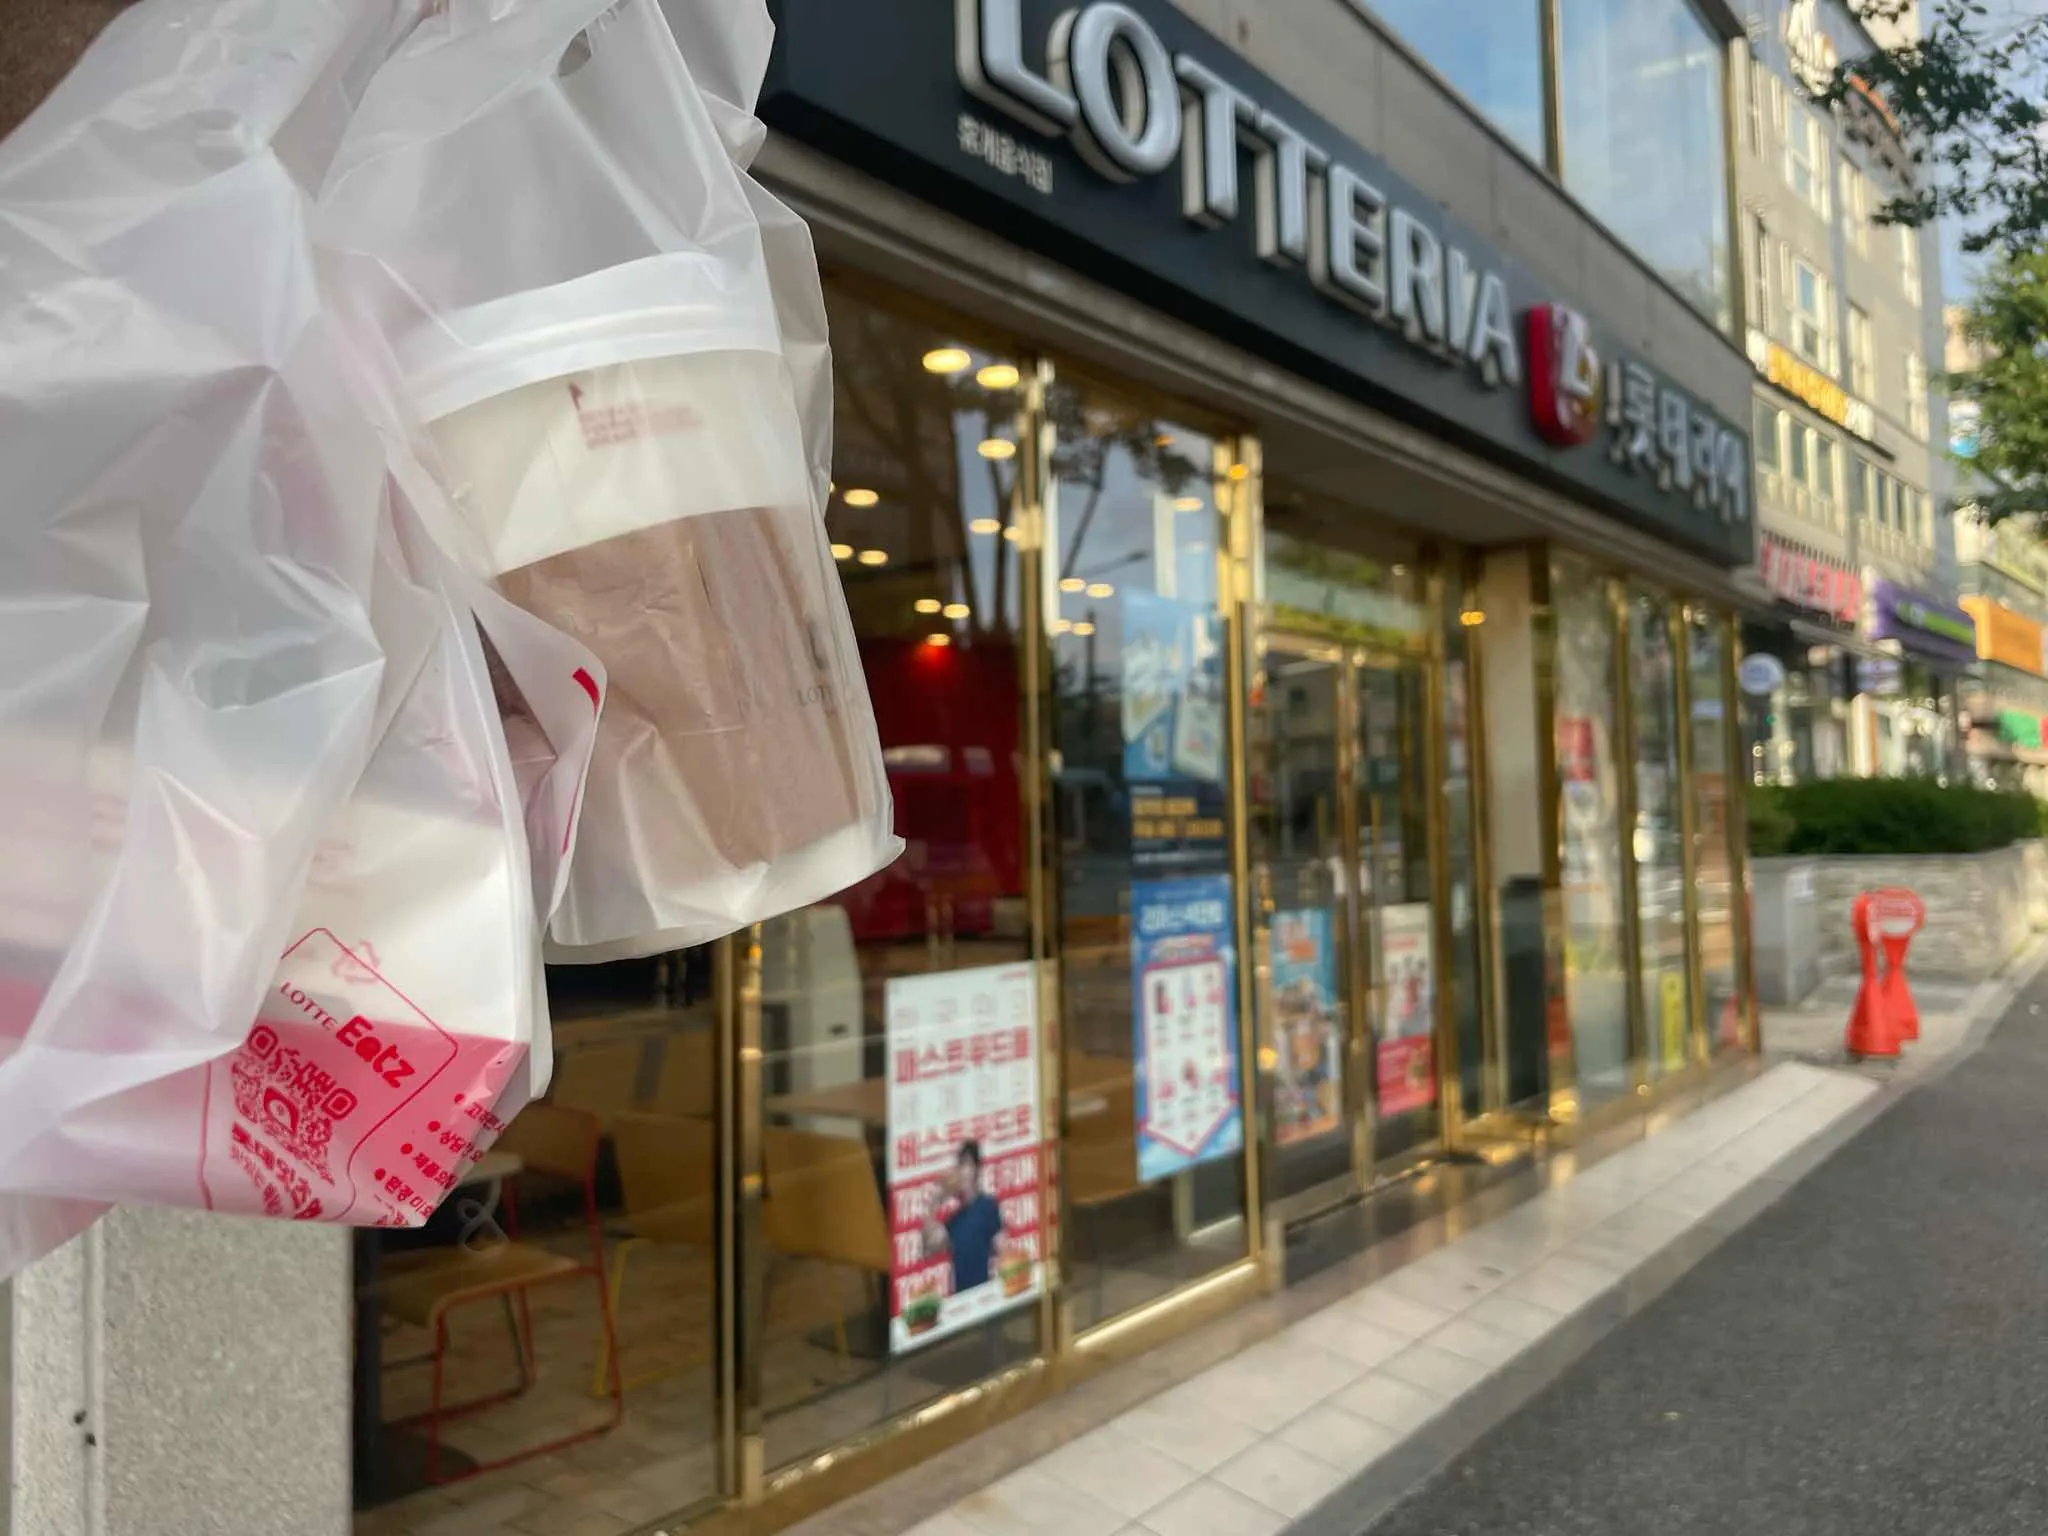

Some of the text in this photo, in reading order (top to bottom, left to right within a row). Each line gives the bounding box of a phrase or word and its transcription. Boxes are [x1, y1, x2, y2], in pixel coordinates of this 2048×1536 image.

[957, 0, 1521, 389] LOTTERIA
[1620, 360, 1748, 521] 롯데리아
[279, 981, 416, 1089] LOTTE Eatz
